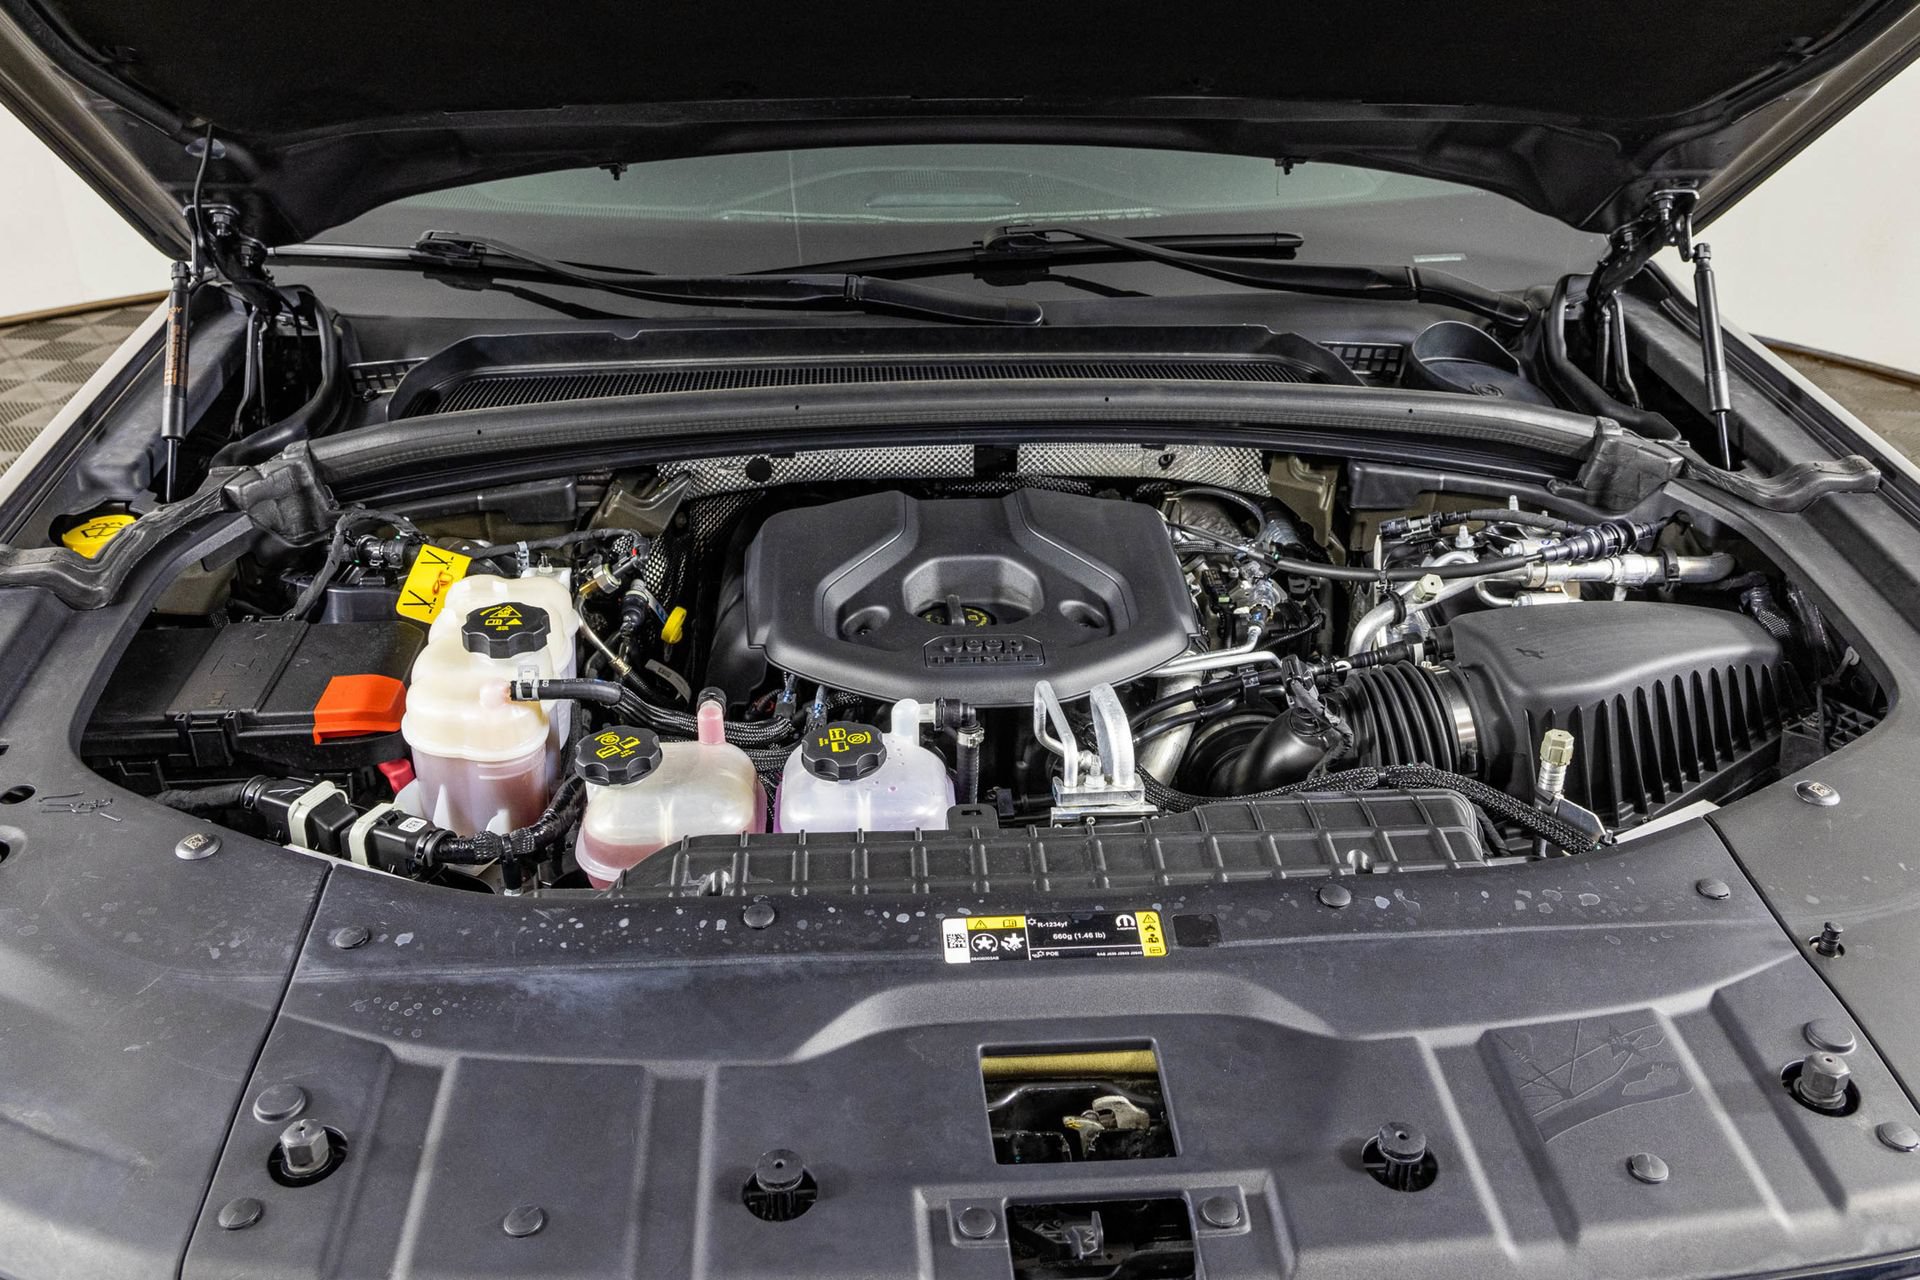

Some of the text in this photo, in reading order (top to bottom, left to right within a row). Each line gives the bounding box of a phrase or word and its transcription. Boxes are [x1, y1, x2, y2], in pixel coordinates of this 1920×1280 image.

[1037, 920, 1068, 929] R-1234yf
[1052, 931, 1106, 941] 660g (1.46 lb)
